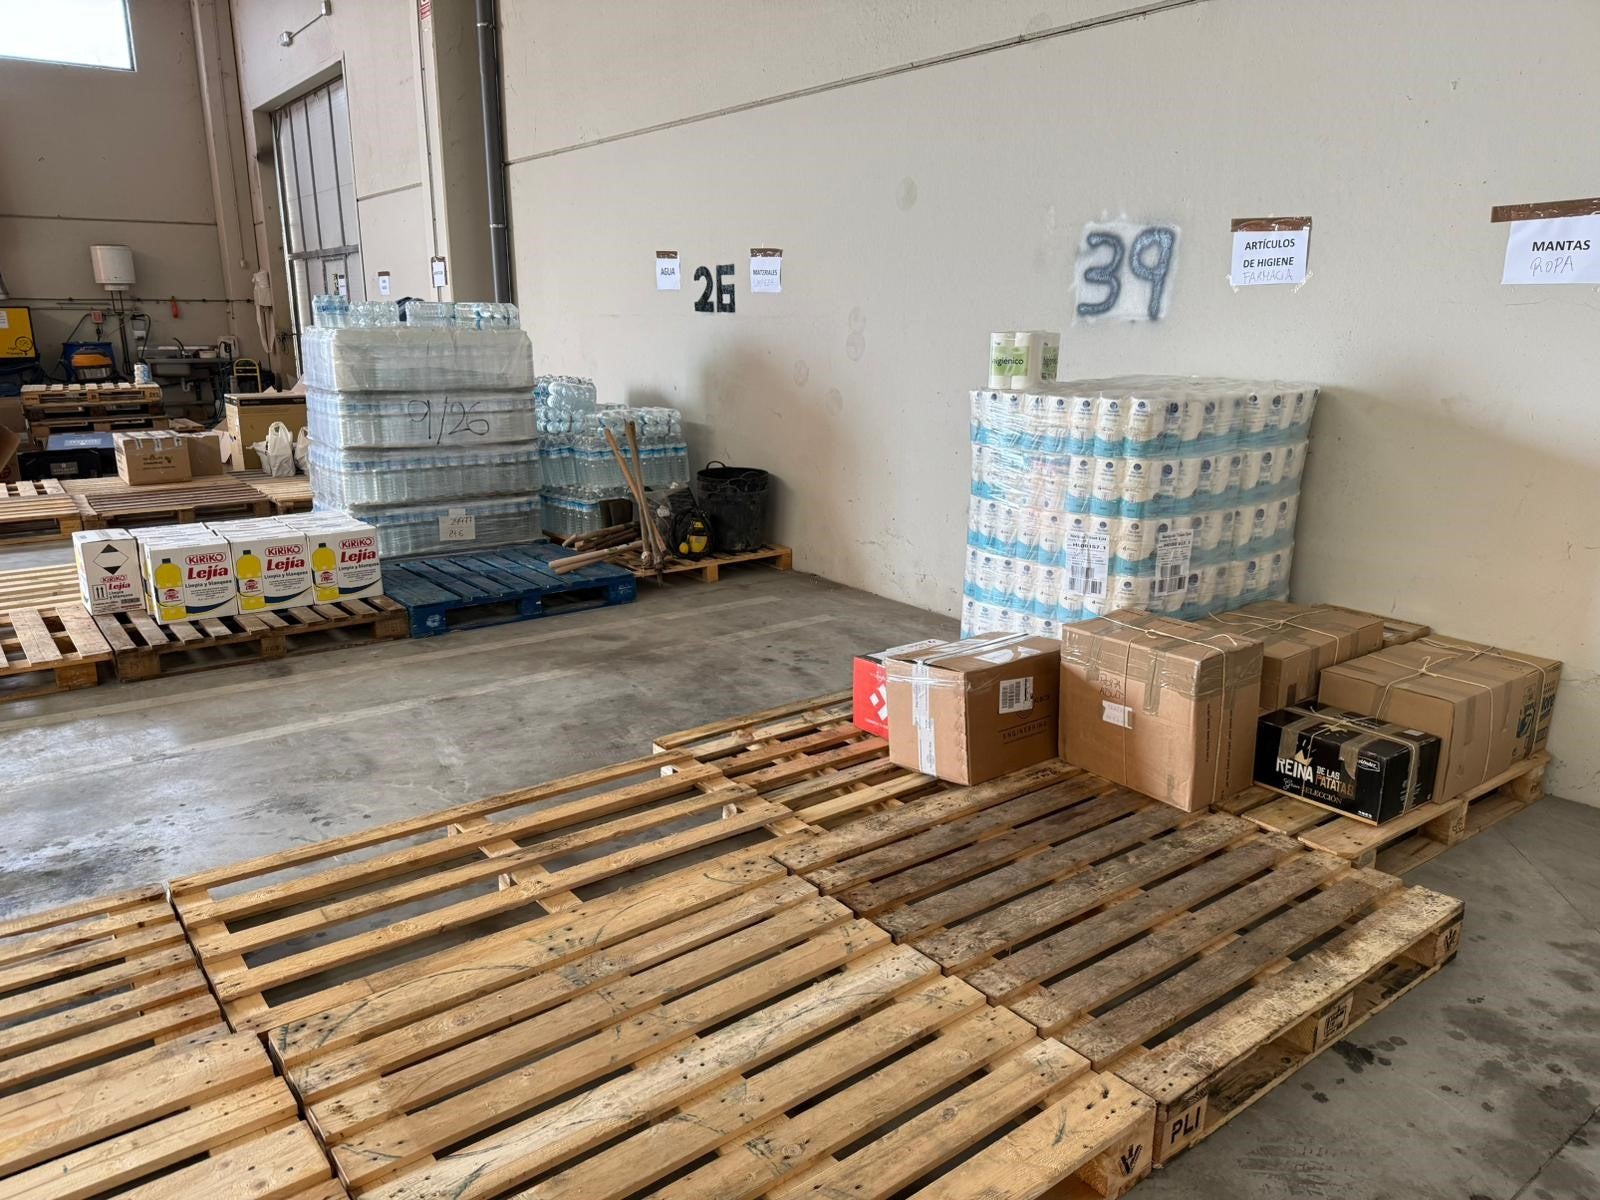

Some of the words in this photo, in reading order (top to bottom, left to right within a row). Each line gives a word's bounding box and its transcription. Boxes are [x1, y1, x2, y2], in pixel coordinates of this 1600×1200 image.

[1244, 238, 1295, 250] ARTÍCULOS
[1531, 239, 1591, 252] MANTAS
[1243, 259, 1255, 268] DE
[1256, 256, 1294, 267] HIGIENE
[1530, 255, 1574, 277] ROPA
[660, 267, 675, 276] AGUA
[1077, 227, 1176, 321] 39
[693, 263, 736, 313] 26
[407, 395, 490, 445] 9/26
[266, 556, 305, 572] Lejía
[340, 548, 377, 564] Lejía
[187, 564, 229, 580] Lejía
[109, 582, 131, 590] Lejía
[1275, 757, 1314, 783] REINA
[1316, 765, 1326, 776] DE
[1326, 769, 1340, 780] LAS
[1315, 774, 1354, 798] PATATAS
[1303, 786, 1342, 804] ELECCIÓN
[1170, 1105, 1201, 1145] PLI
